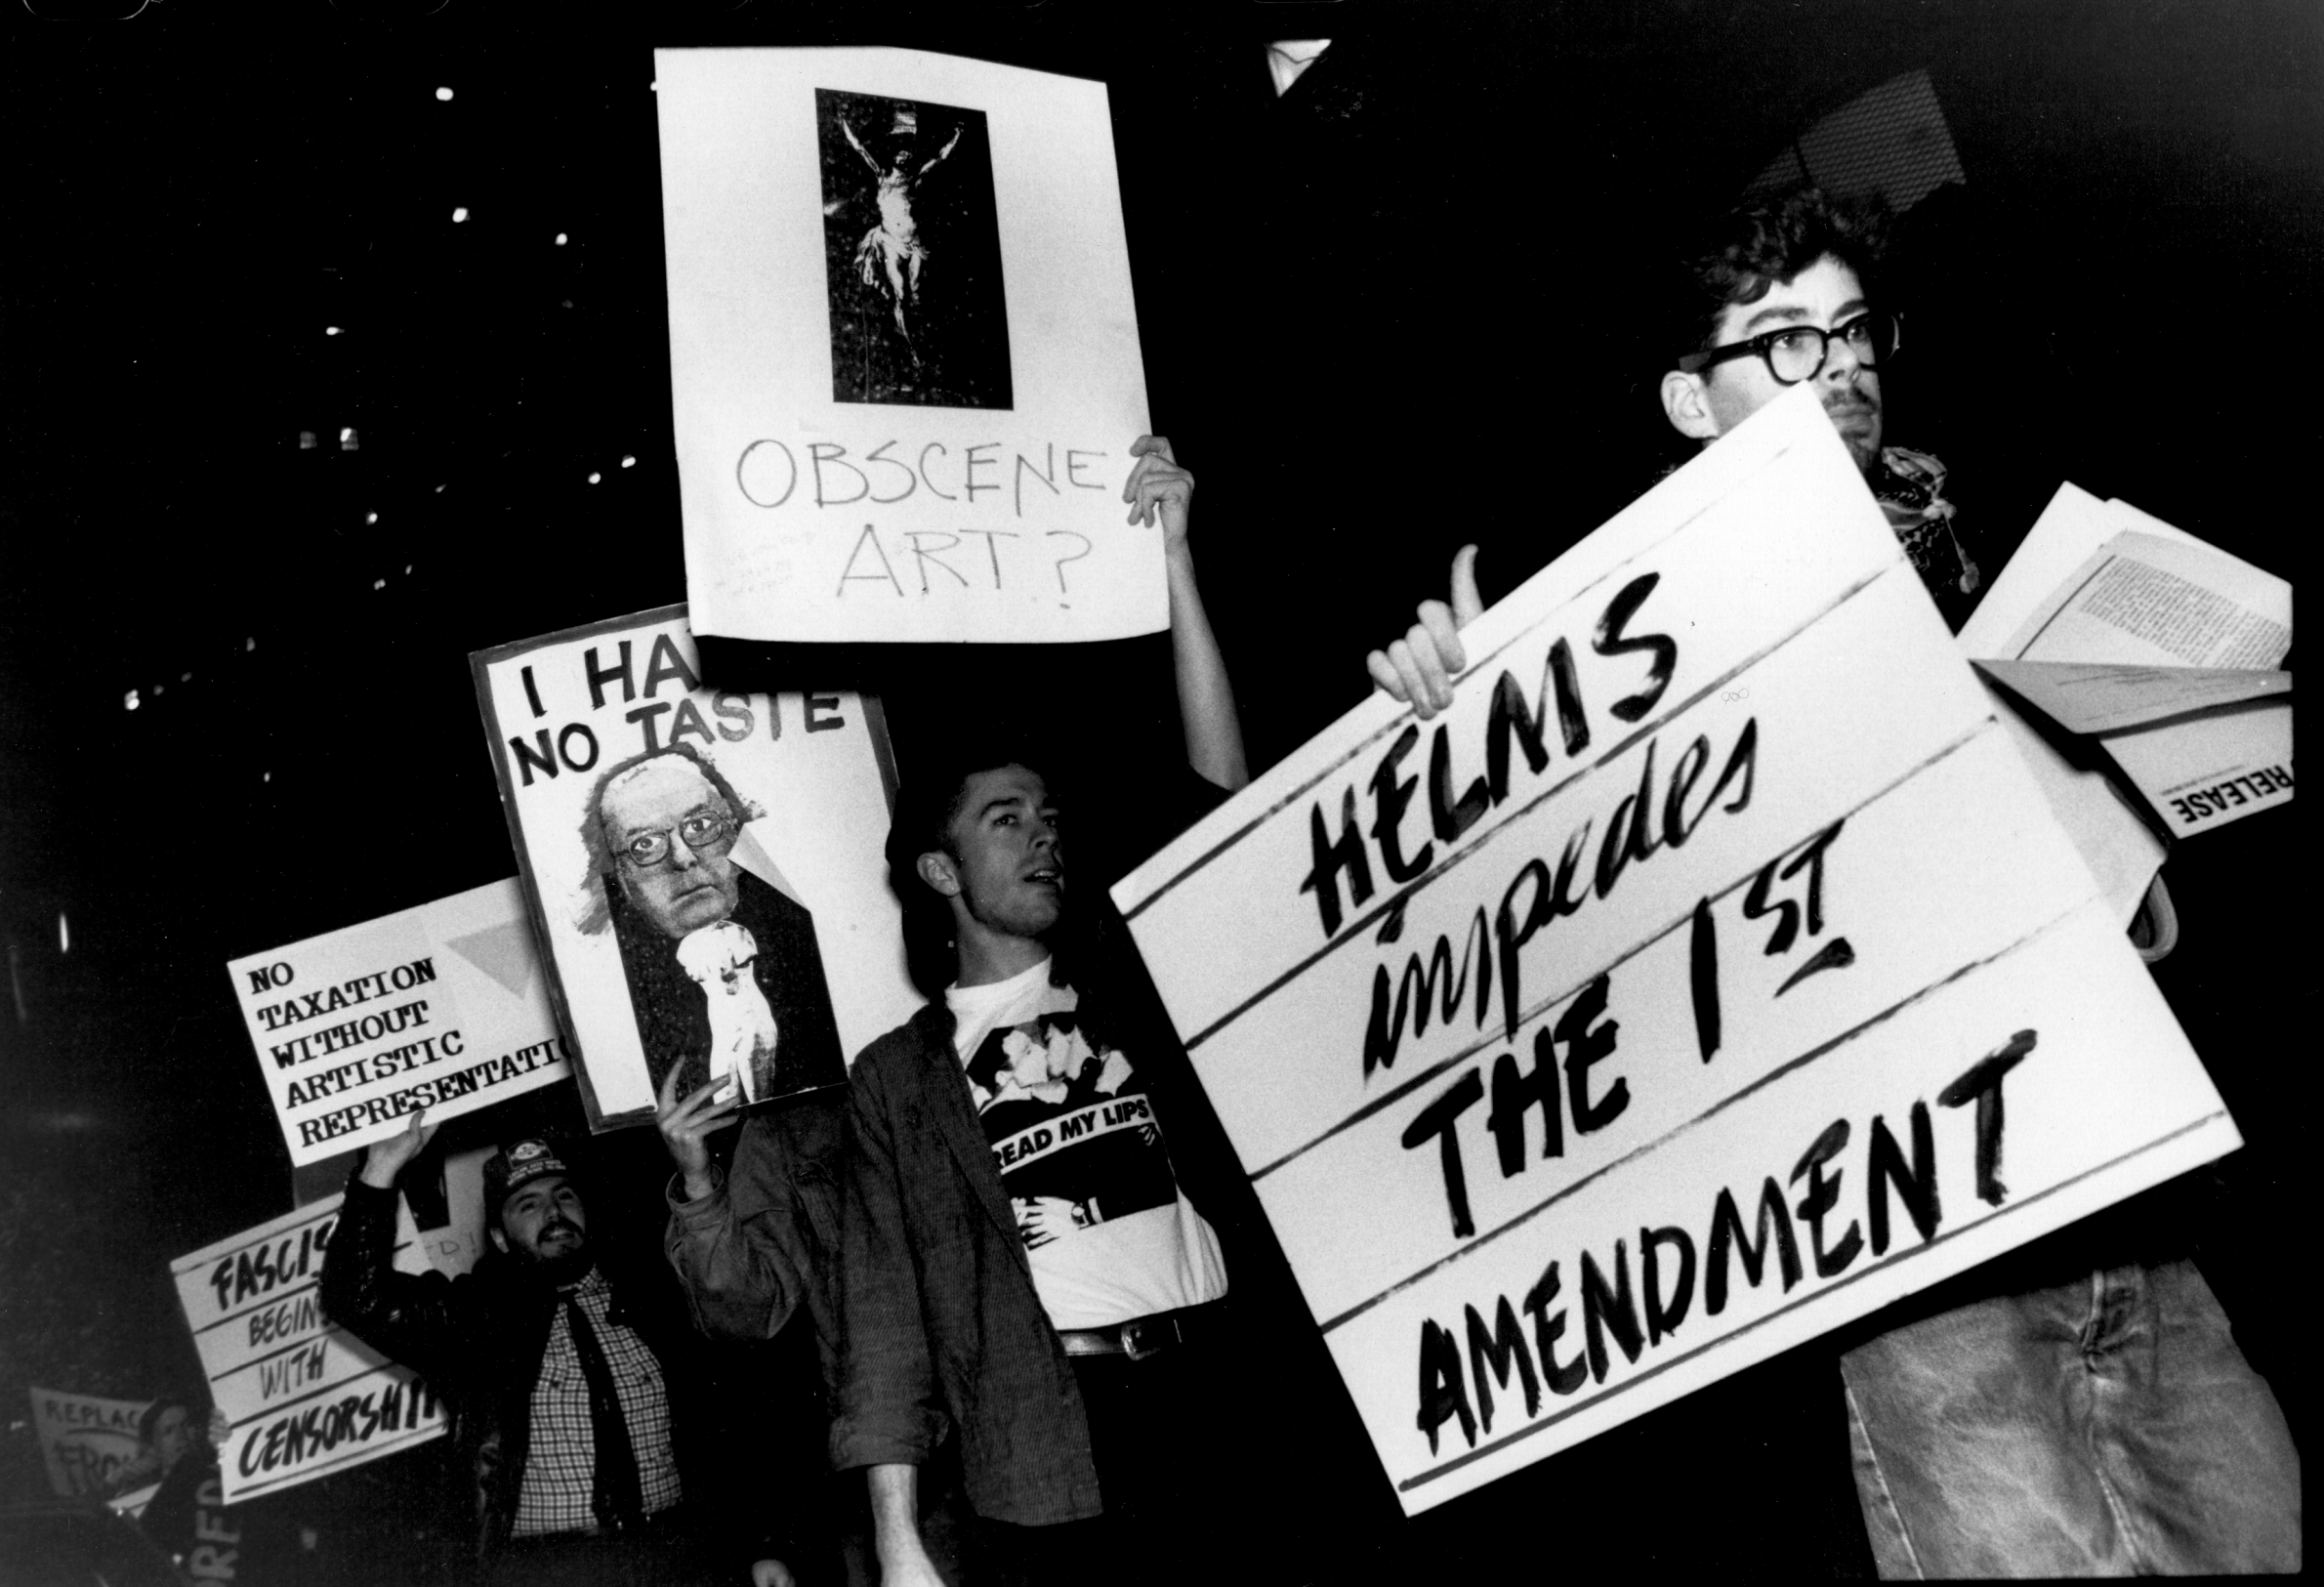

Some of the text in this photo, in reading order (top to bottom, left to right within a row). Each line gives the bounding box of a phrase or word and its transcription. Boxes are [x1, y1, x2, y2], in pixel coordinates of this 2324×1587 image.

[737, 439, 1107, 517] OBSCENE
[837, 523, 1092, 610] ART?
[521, 665, 547, 719] I
[509, 723, 599, 787] NO
[1297, 572, 1677, 938] HELMS
[2170, 764, 2294, 823] RELEASE
[1365, 718, 1757, 1084] impedes
[247, 962, 294, 994] NO
[257, 957, 436, 1031] TAXATION
[270, 1000, 429, 1069] WITHOUT
[286, 1030, 464, 1109] ARTISTIC
[1060, 1110, 1096, 1141] MY
[1102, 1099, 1149, 1125] LIPS
[1401, 972, 1630, 1238] THE
[1418, 1028, 2037, 1455] AMENDMENT
[261, 1340, 328, 1399] WITH
